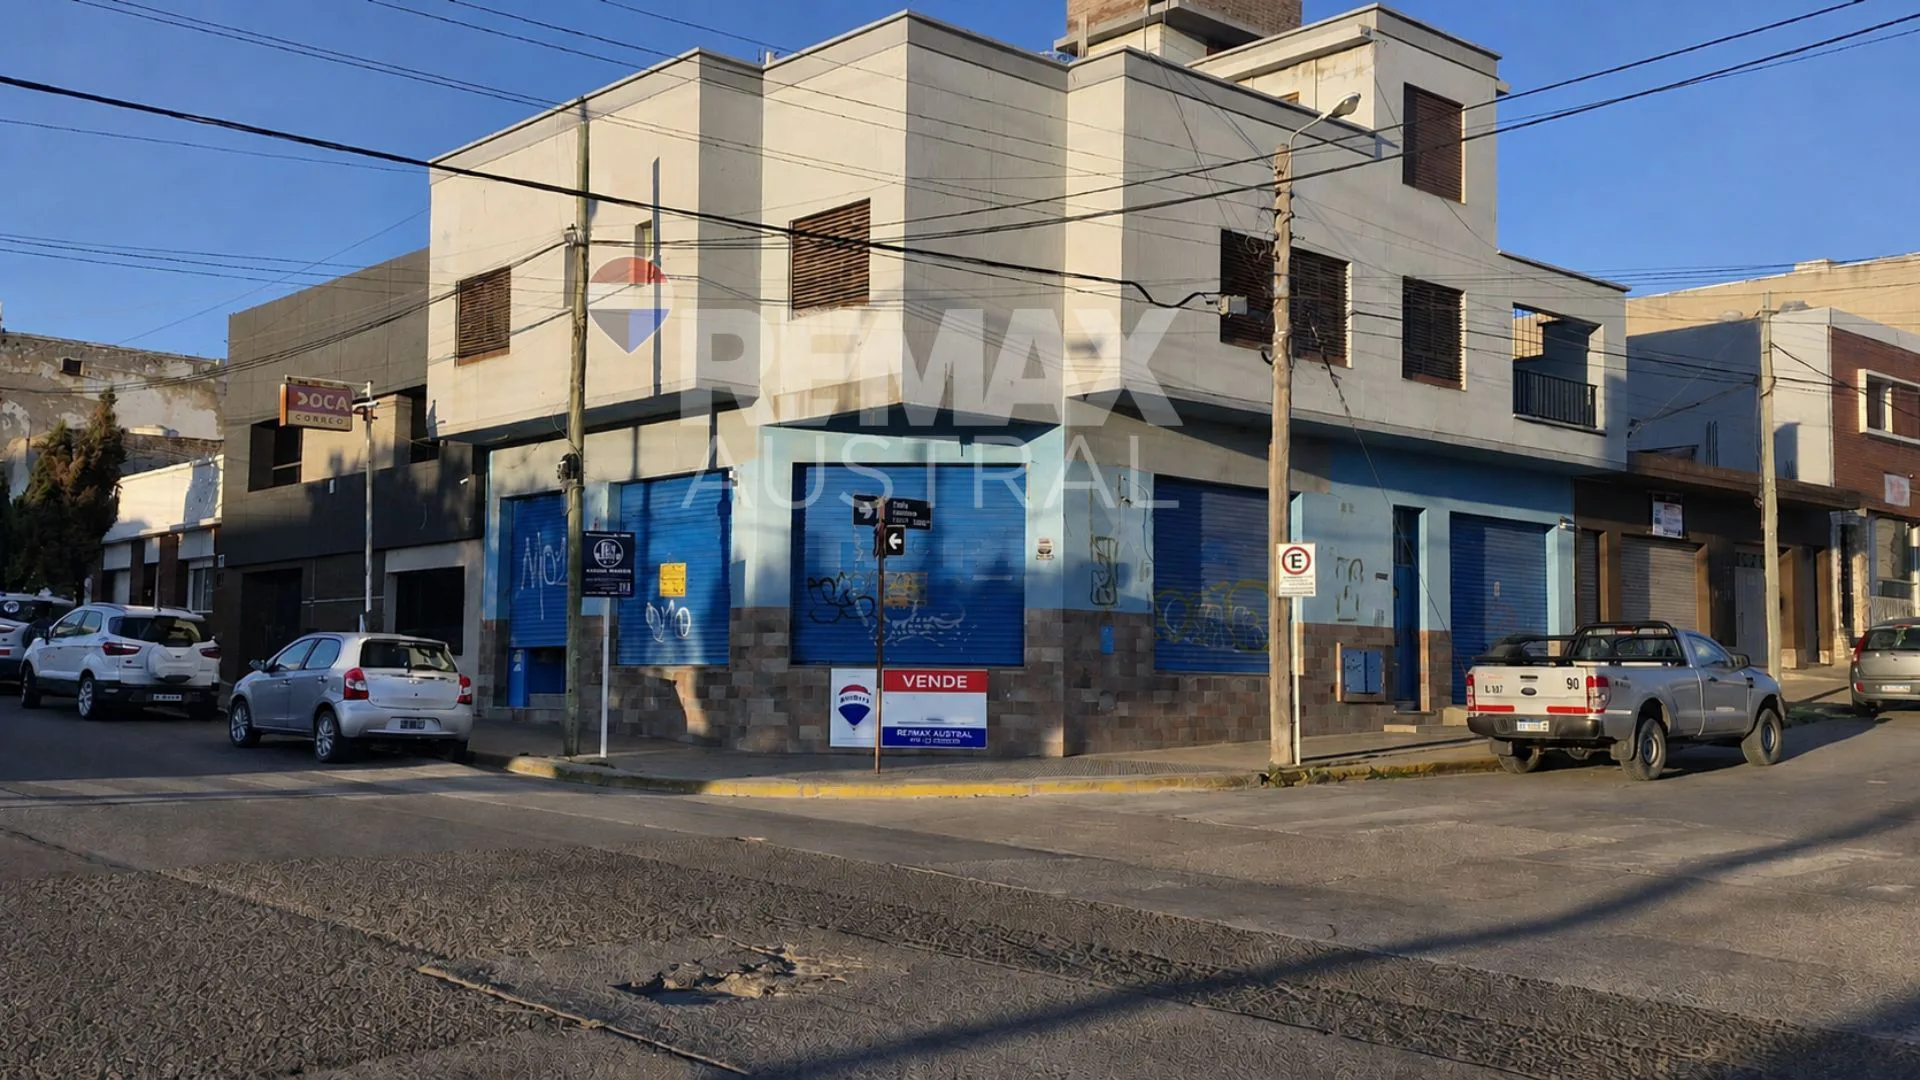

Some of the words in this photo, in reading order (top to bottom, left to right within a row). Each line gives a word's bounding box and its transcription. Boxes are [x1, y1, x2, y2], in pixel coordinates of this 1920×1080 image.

[1291, 553, 1302, 569] E
[902, 675, 968, 689] VENDE
[1566, 677, 1579, 690] 90
